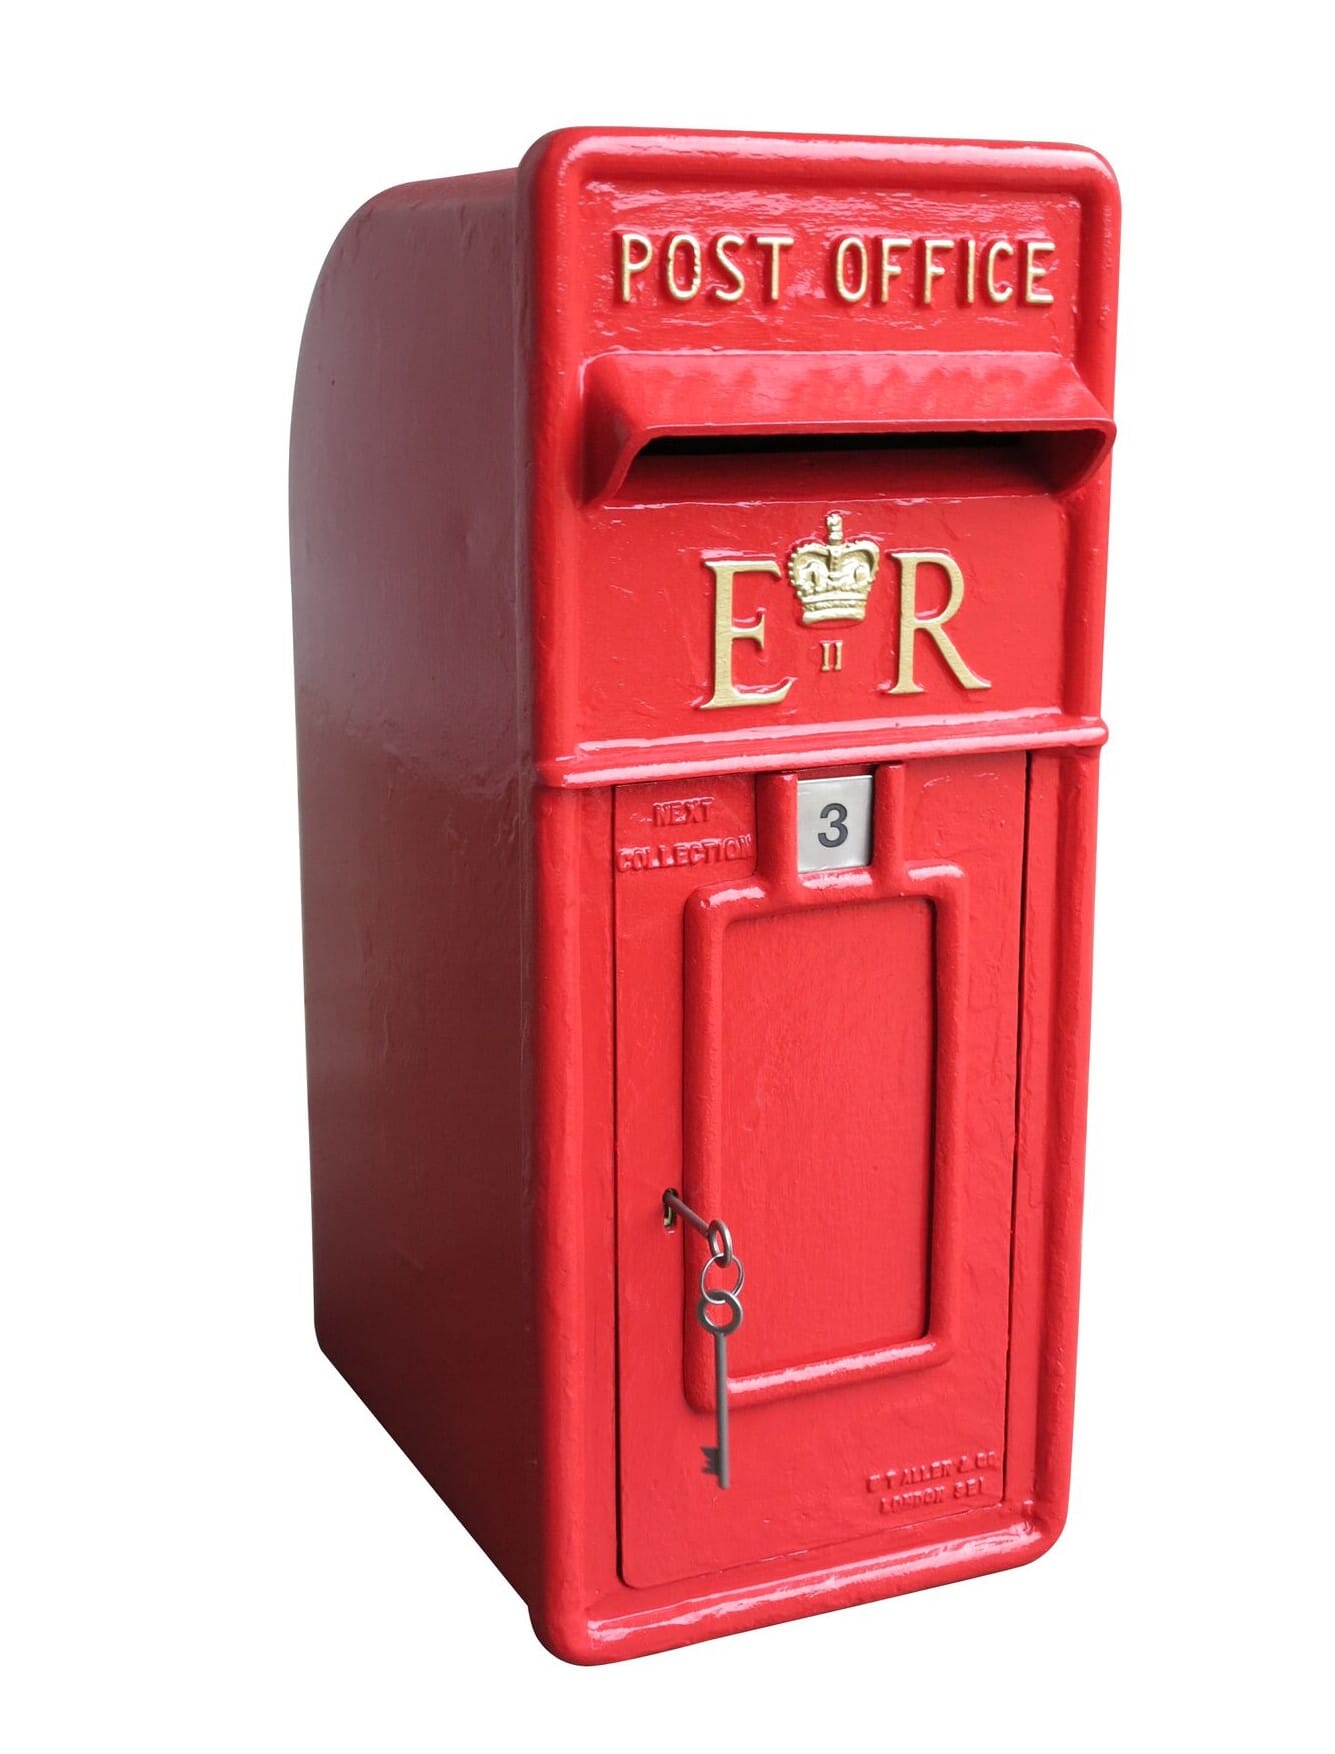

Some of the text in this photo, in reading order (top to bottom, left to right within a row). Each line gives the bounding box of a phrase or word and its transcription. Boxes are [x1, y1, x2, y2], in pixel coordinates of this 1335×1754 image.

[617, 232, 1056, 306] POST OFFICE
[699, 550, 993, 711] E R
[818, 640, 844, 673] II
[652, 796, 715, 828] NEXT
[816, 802, 849, 848] 3
[616, 833, 753, 874] COLLECTION
